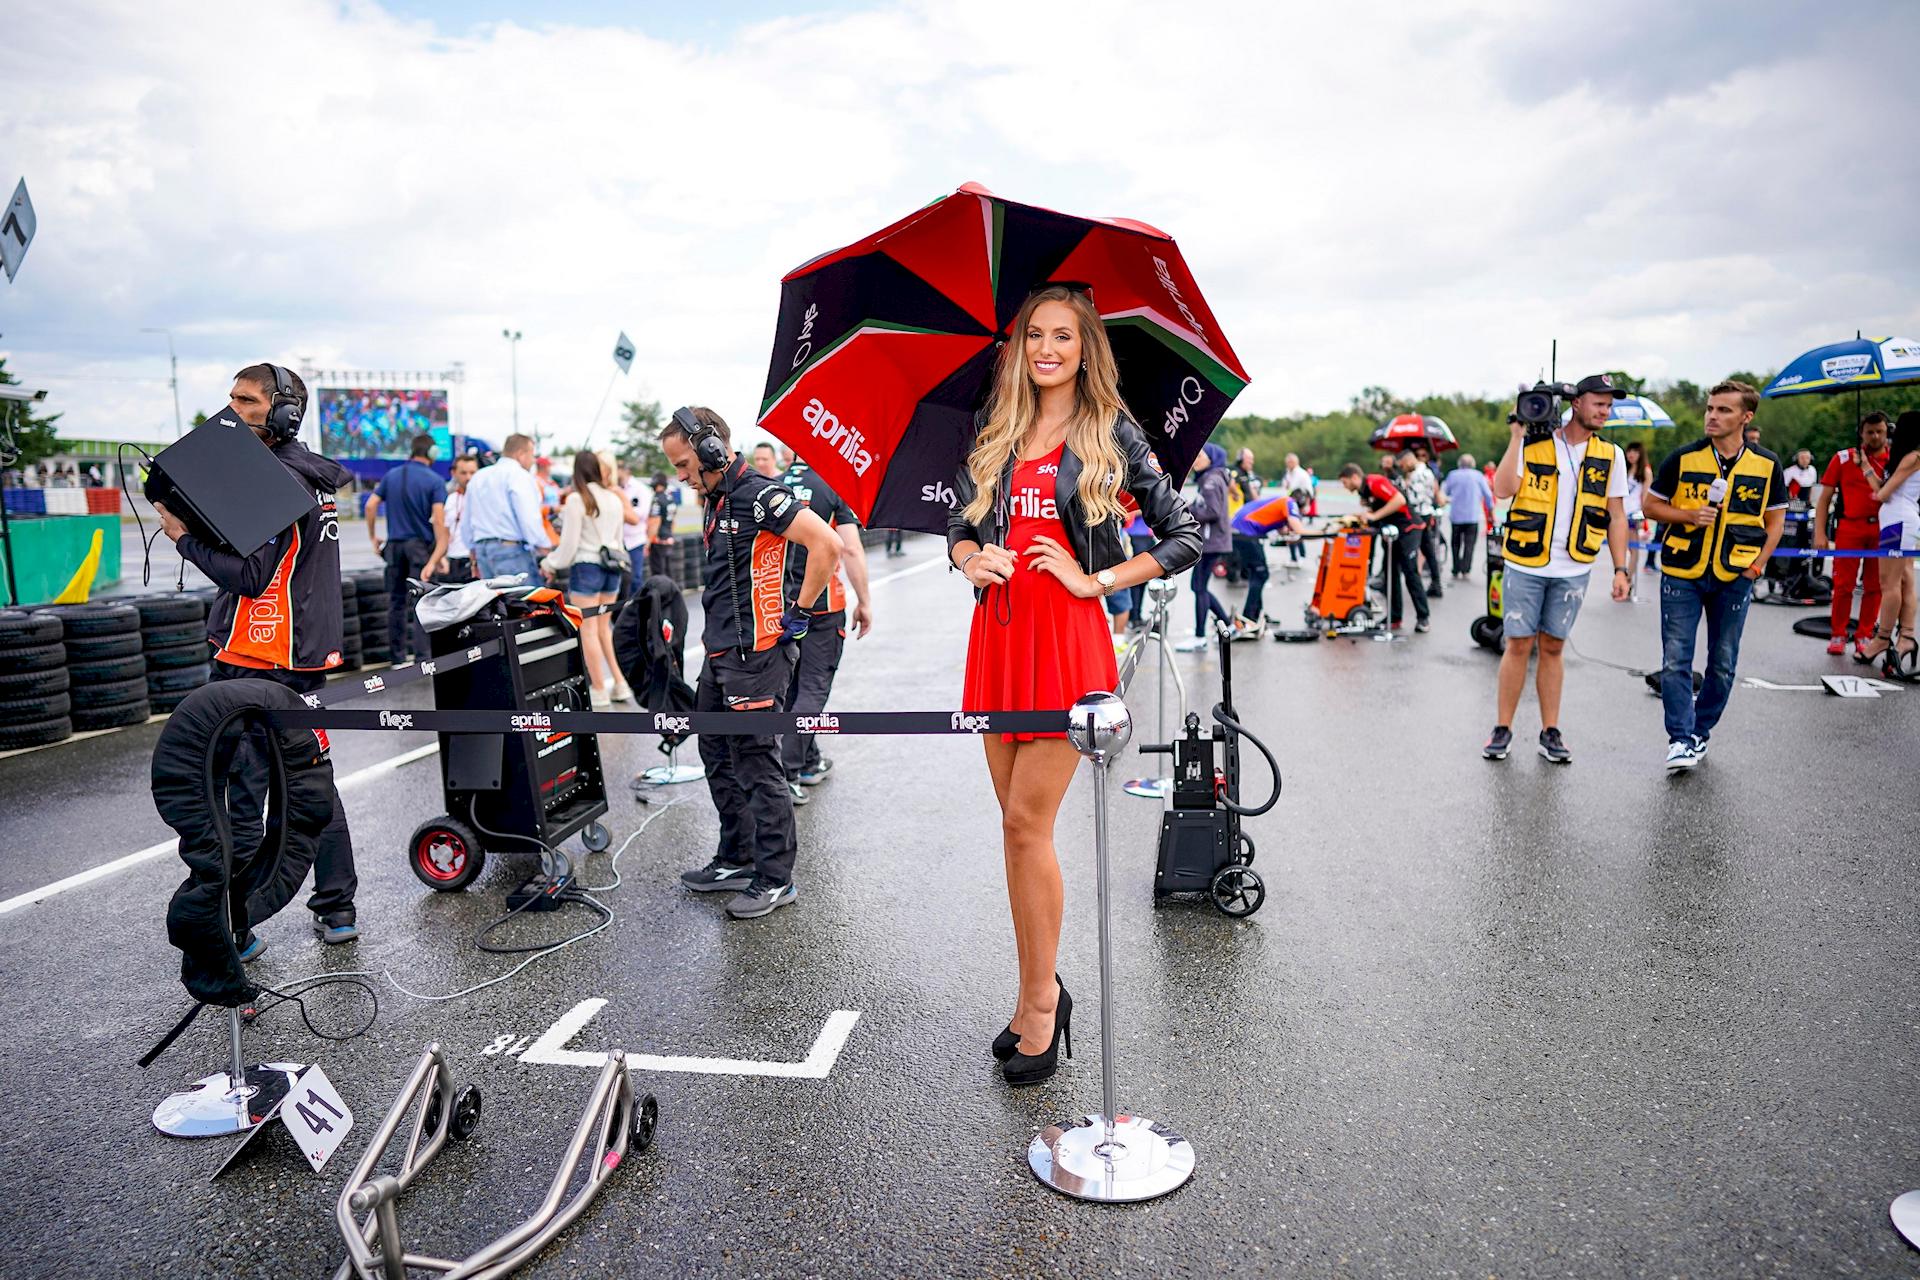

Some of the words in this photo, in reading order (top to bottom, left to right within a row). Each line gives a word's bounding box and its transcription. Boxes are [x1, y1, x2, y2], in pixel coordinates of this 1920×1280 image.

[797, 303, 818, 341] sky
[615, 346, 633, 361] 8
[791, 342, 811, 371] Q
[1164, 398, 1189, 439] sky
[1181, 377, 1205, 405] Q
[802, 398, 873, 478] aprilia
[1036, 462, 1058, 478] sky
[921, 481, 957, 509] sky
[1685, 488, 1708, 500] 144
[752, 550, 787, 635] aprilia
[1837, 679, 1859, 692] 17
[379, 710, 413, 730] flex
[510, 712, 551, 728] aprilia
[654, 712, 690, 733] flex
[796, 713, 840, 730] aprilia
[950, 712, 990, 733] flex
[295, 1088, 344, 1135] 41
